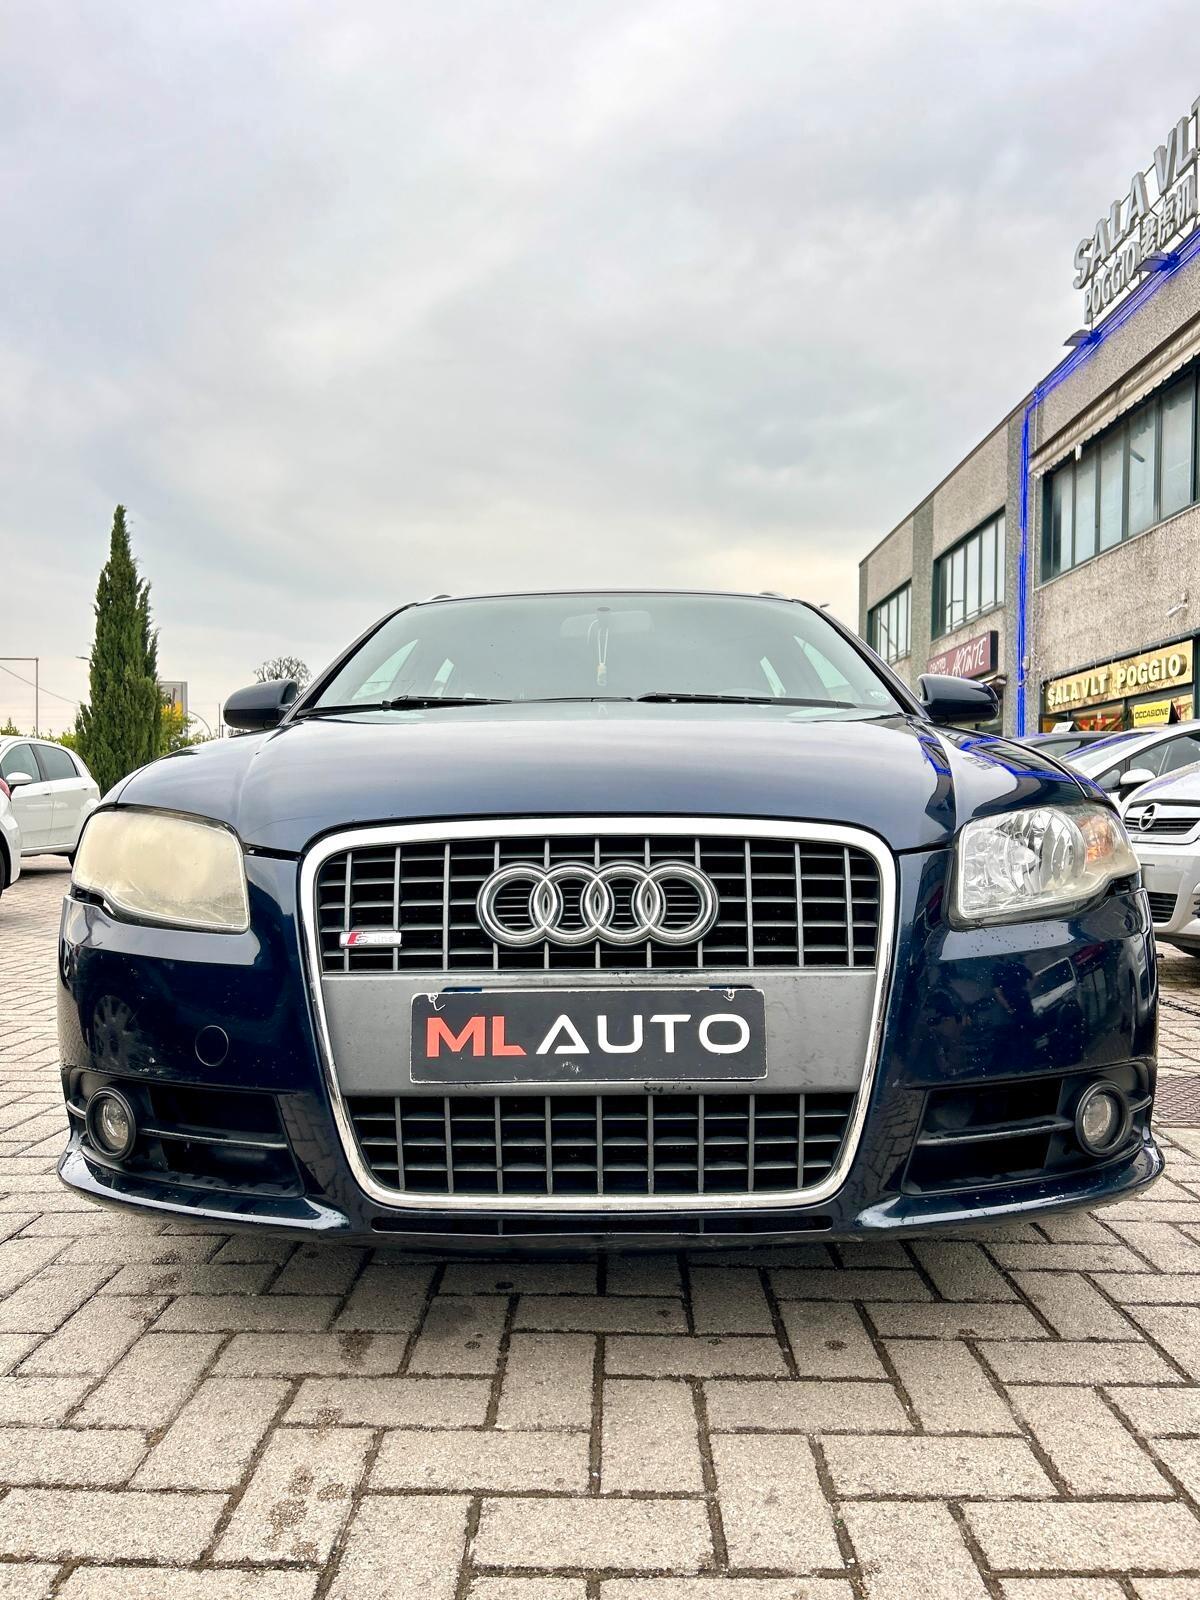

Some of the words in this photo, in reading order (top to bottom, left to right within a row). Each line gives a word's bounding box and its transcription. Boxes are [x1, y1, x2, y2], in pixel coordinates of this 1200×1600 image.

[1073, 171, 1150, 289] SALA
[1084, 241, 1142, 324] POGGIO
[1047, 682, 1079, 706] SALA
[1081, 673, 1108, 697] VLT
[1116, 653, 1182, 689] POGGIO
[1134, 707, 1169, 719] OCCASIONE
[426, 1015, 527, 1057] ML
[536, 1013, 751, 1055] AUTO
